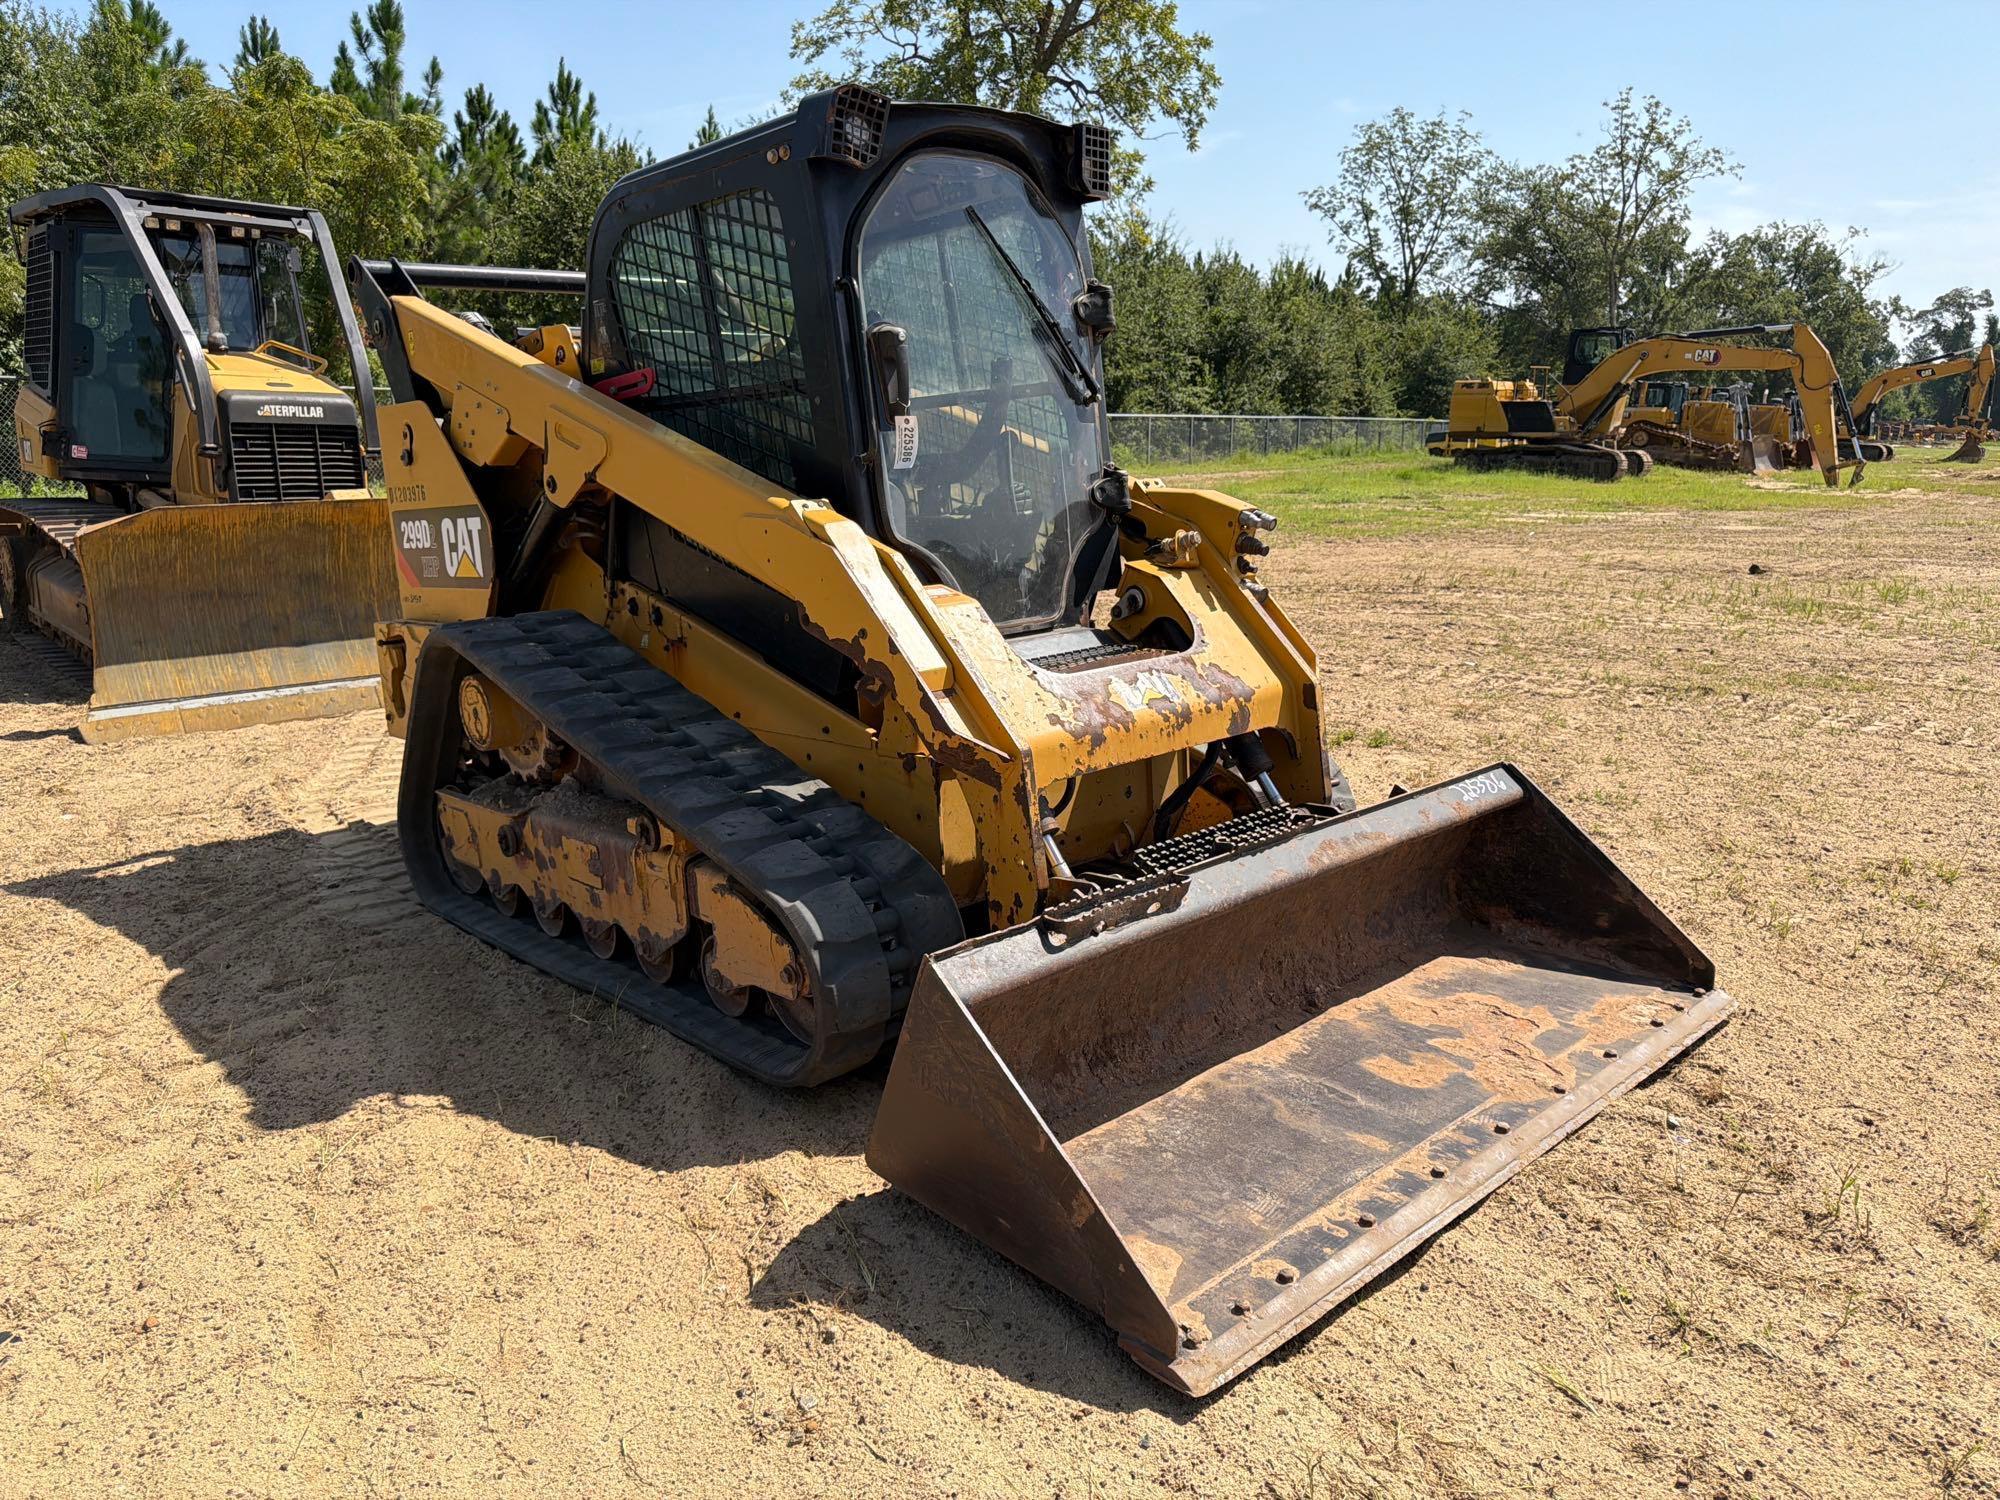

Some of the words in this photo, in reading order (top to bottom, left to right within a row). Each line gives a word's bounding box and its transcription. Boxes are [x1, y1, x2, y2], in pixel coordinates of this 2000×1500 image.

[1695, 350, 1717, 362] CAT
[1921, 369, 1932, 377] CAT
[902, 427, 915, 462] 225386
[441, 516, 484, 578] CAT
